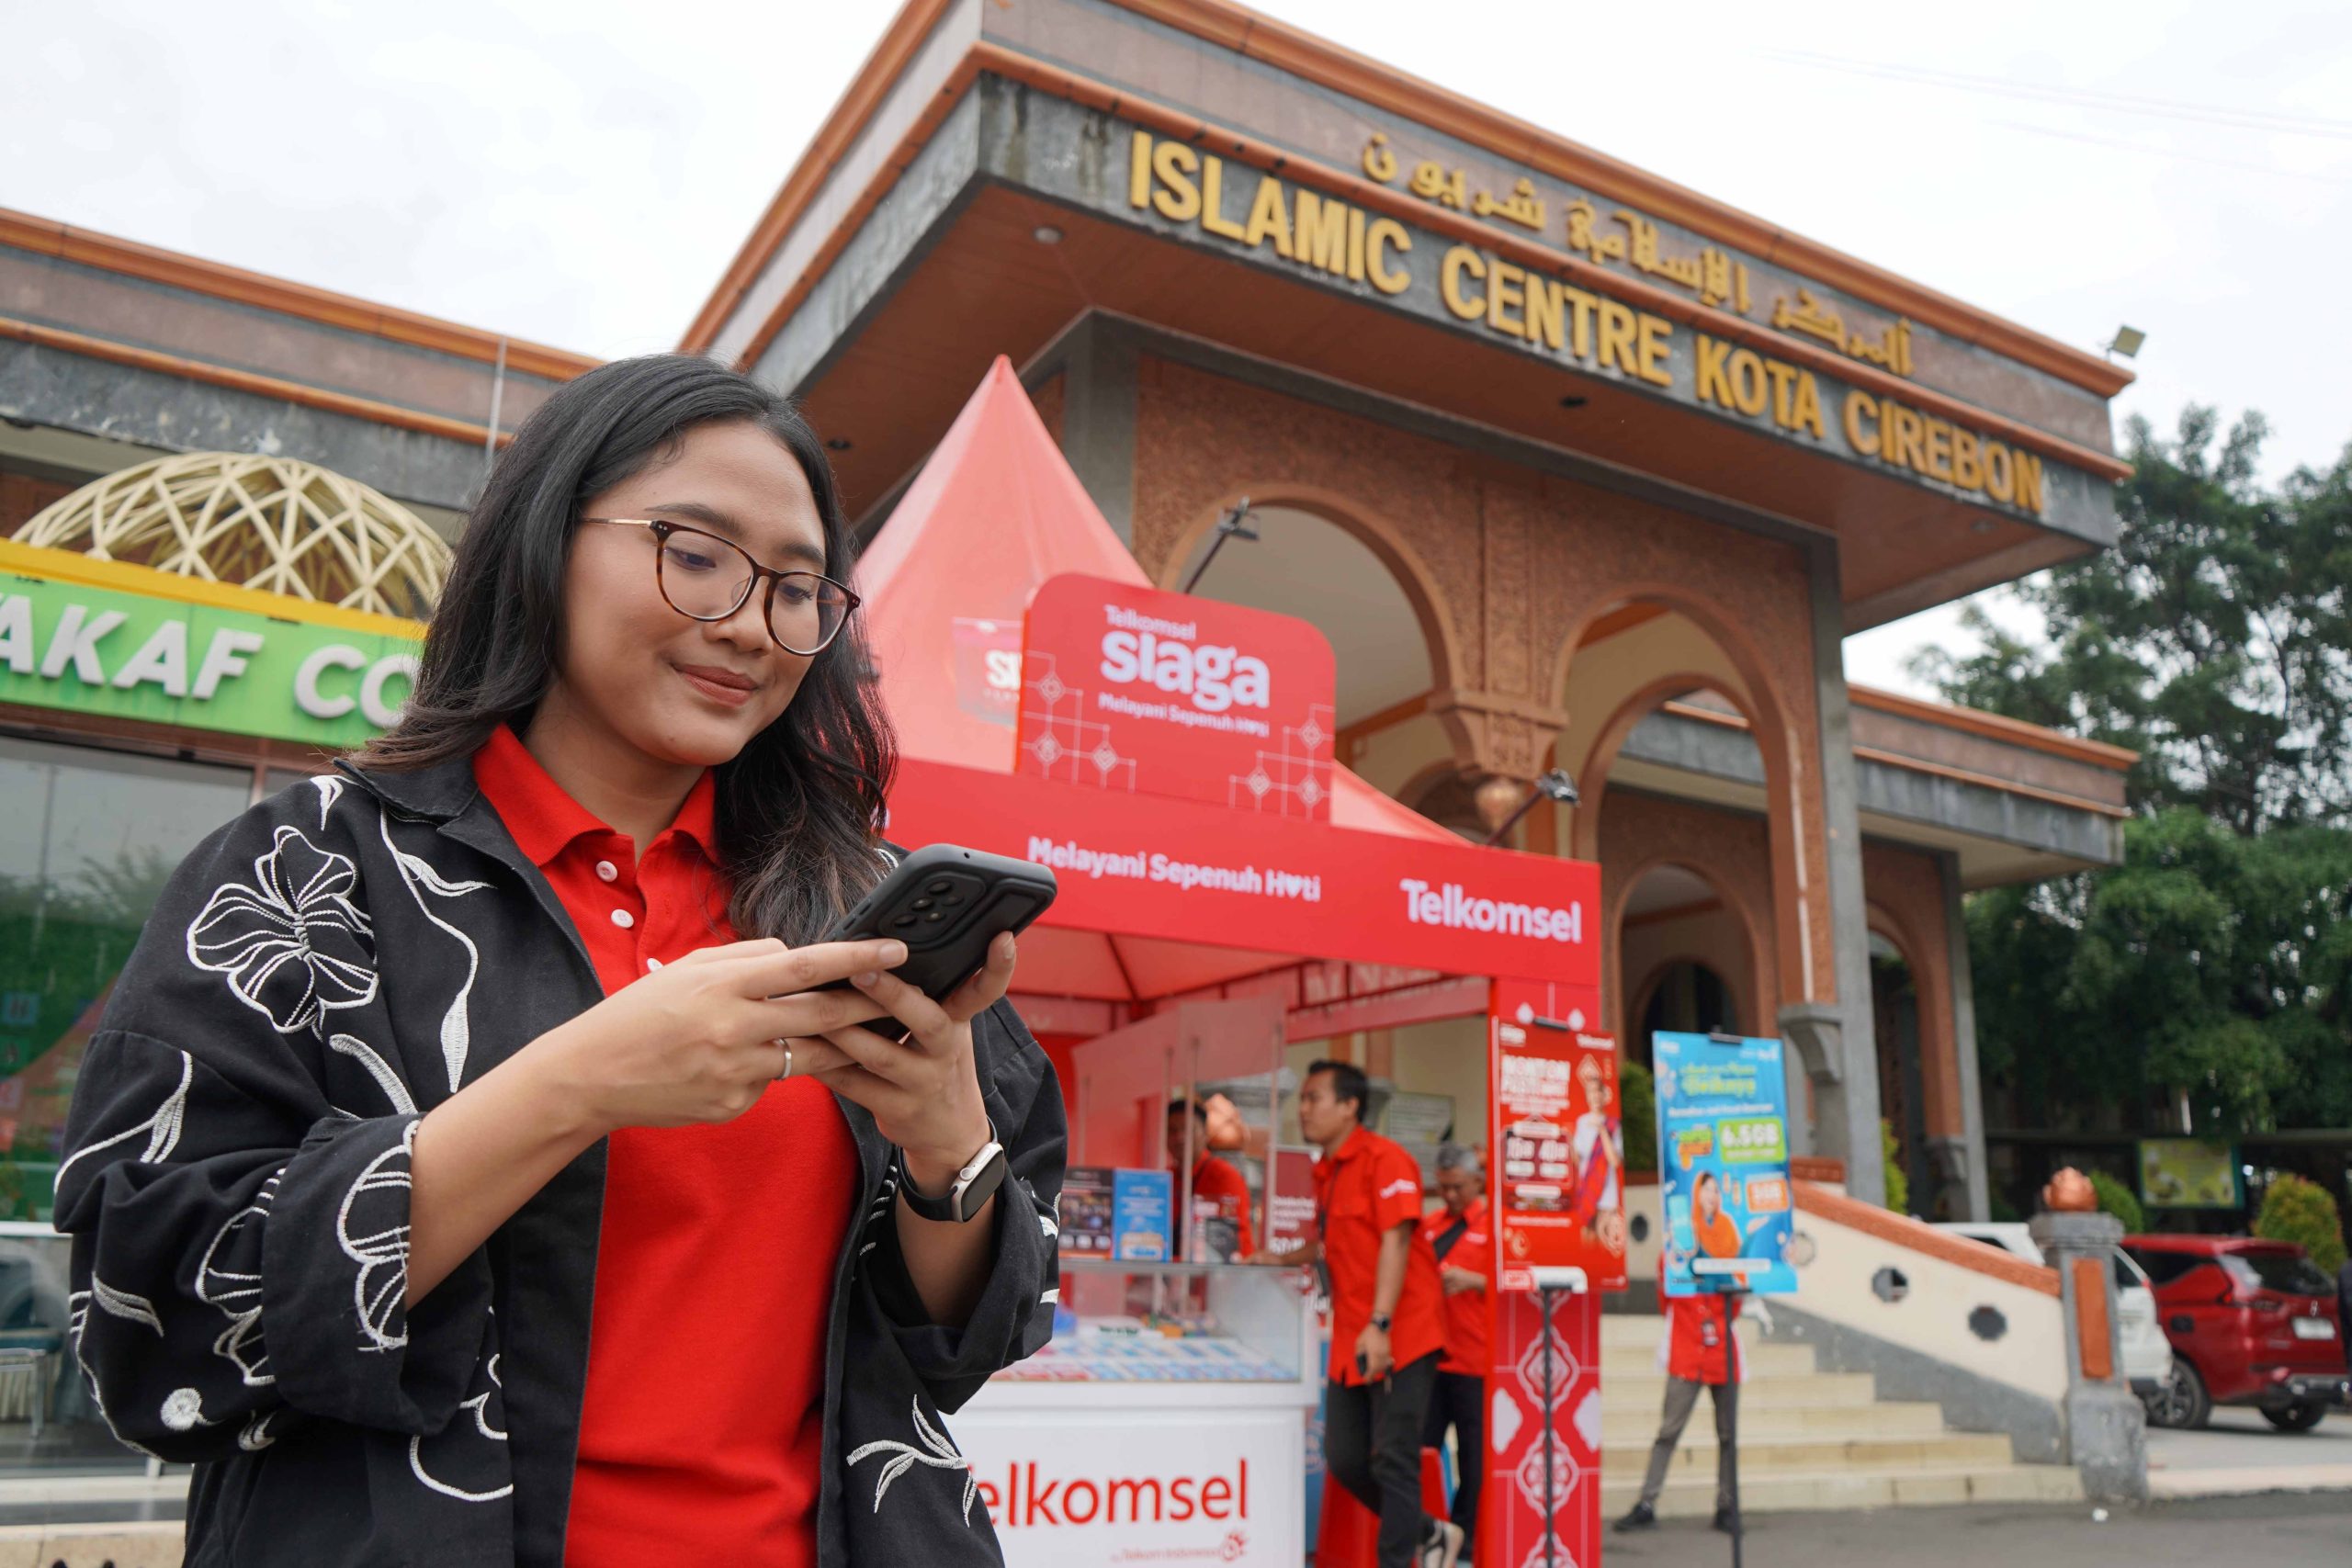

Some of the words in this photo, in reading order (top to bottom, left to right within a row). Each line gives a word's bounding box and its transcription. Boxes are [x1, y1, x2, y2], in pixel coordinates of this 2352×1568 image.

[1129, 129, 1413, 295] ISLAMIC
[1441, 245, 1674, 388] CENTRE
[1695, 332, 1826, 440] KOTA
[1842, 389, 2044, 515] CIREBON
[0, 591, 266, 701] AKAF
[1104, 604, 1197, 641] Telkomsel
[1098, 692, 1168, 720] Melayani
[1169, 704, 1234, 732] Sepenuh
[1027, 835, 1148, 879] Melayani
[1149, 852, 1263, 895] Sepenuh
[1399, 877, 1582, 944] Telkomsel
[968, 1457, 1248, 1529] elkomsel
